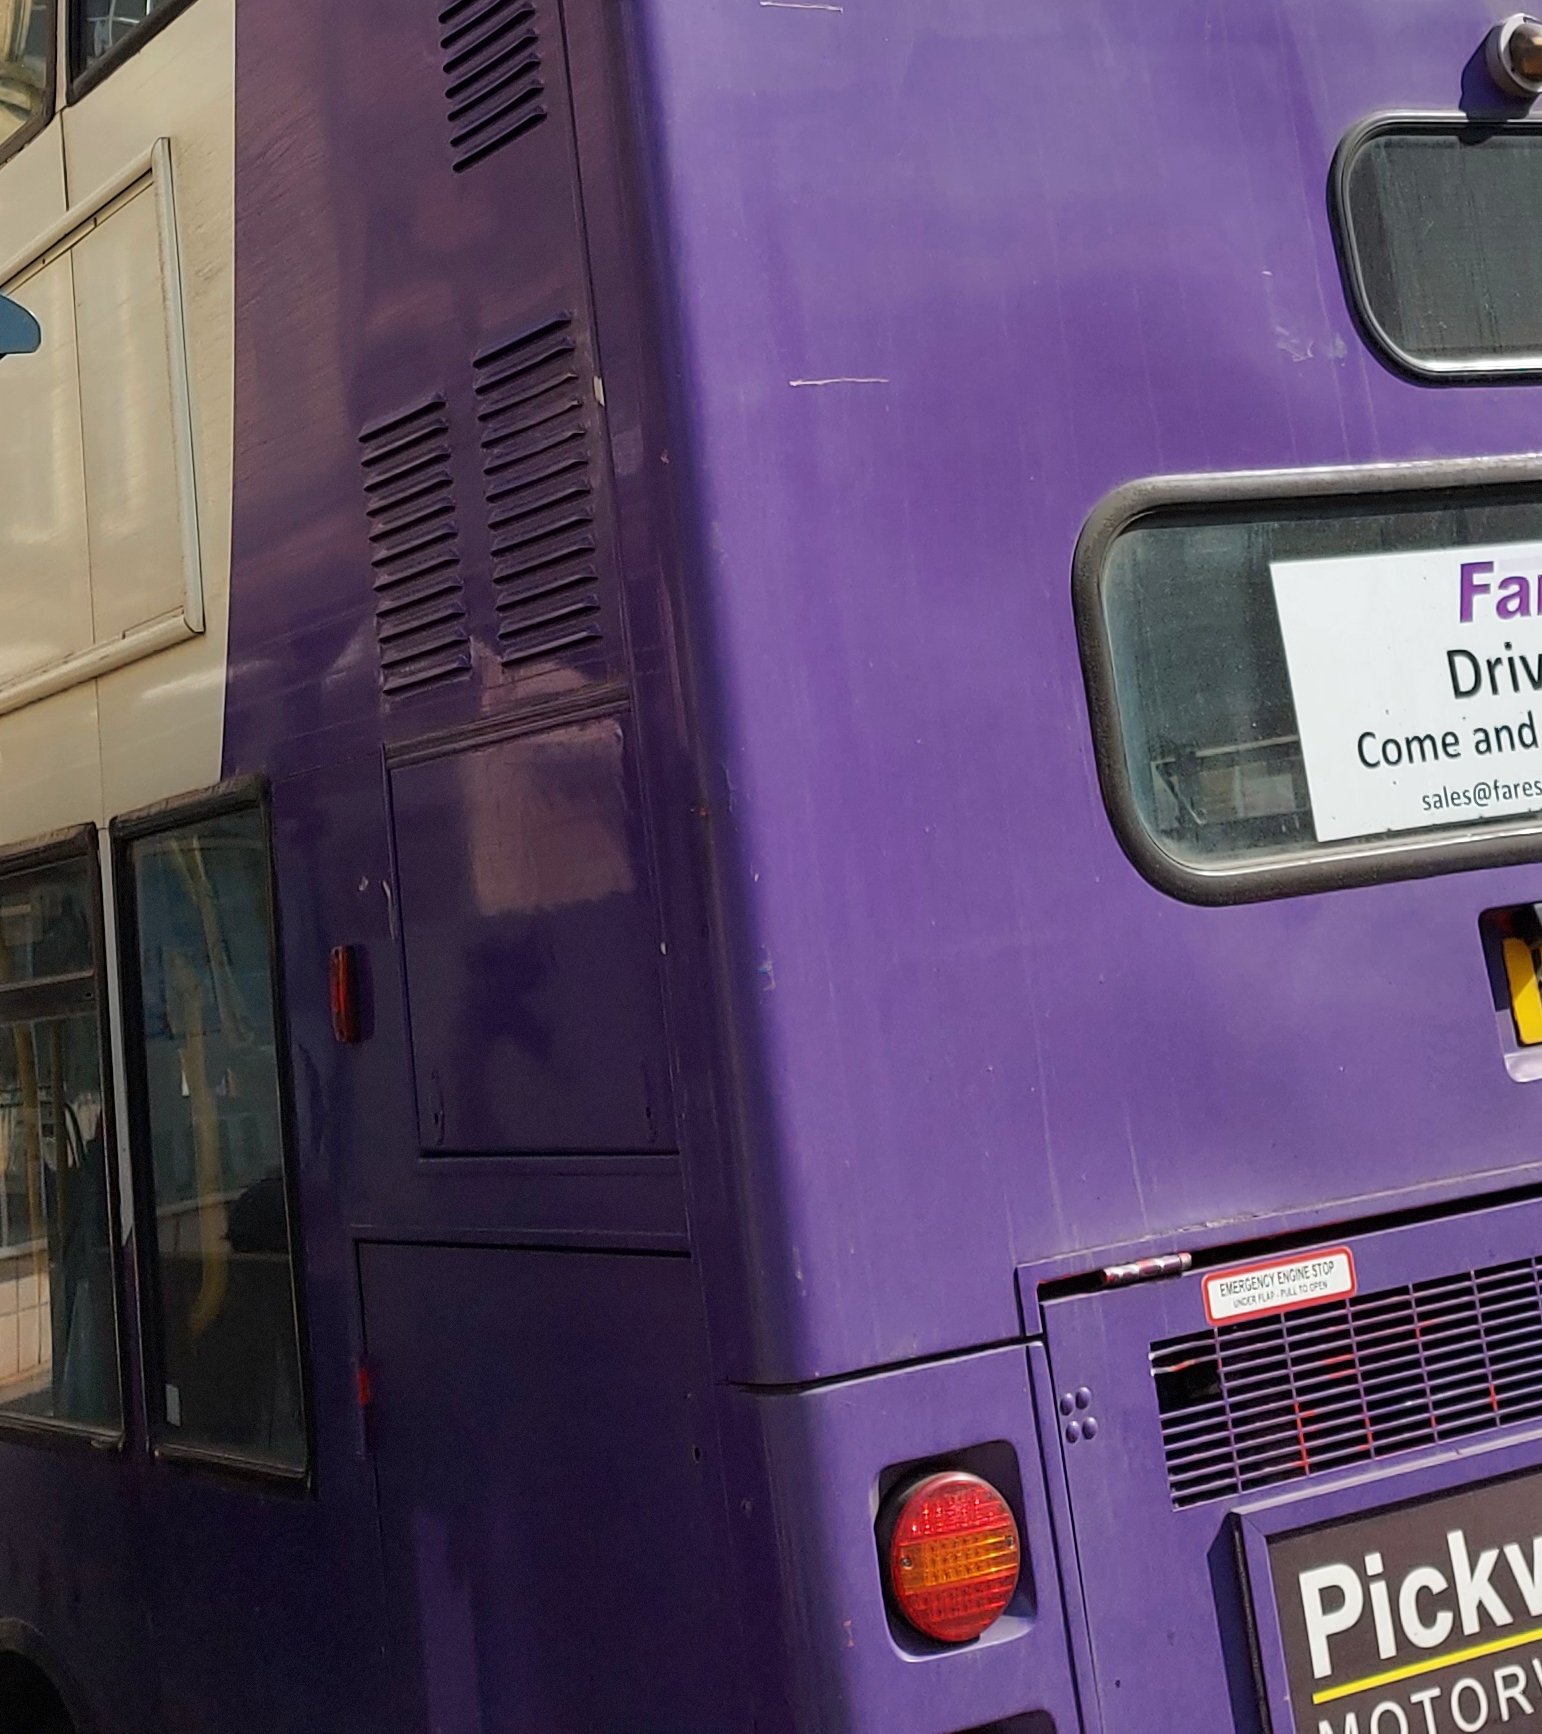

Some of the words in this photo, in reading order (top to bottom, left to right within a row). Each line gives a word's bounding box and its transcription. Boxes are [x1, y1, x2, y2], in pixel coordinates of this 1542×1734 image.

[1358, 729, 1461, 769] Come
[1473, 711, 1539, 756] and
[1220, 1273, 1274, 1297] EMERGENCY
[1278, 1264, 1310, 1285] ENGINE
[1312, 1261, 1334, 1278] STOP
[1233, 1294, 1257, 1308] UNDER
[1259, 1291, 1275, 1304] FLAP
[1280, 1288, 1297, 1299] PULL
[1299, 1284, 1308, 1294] TO
[1310, 1281, 1328, 1293] OPEN
